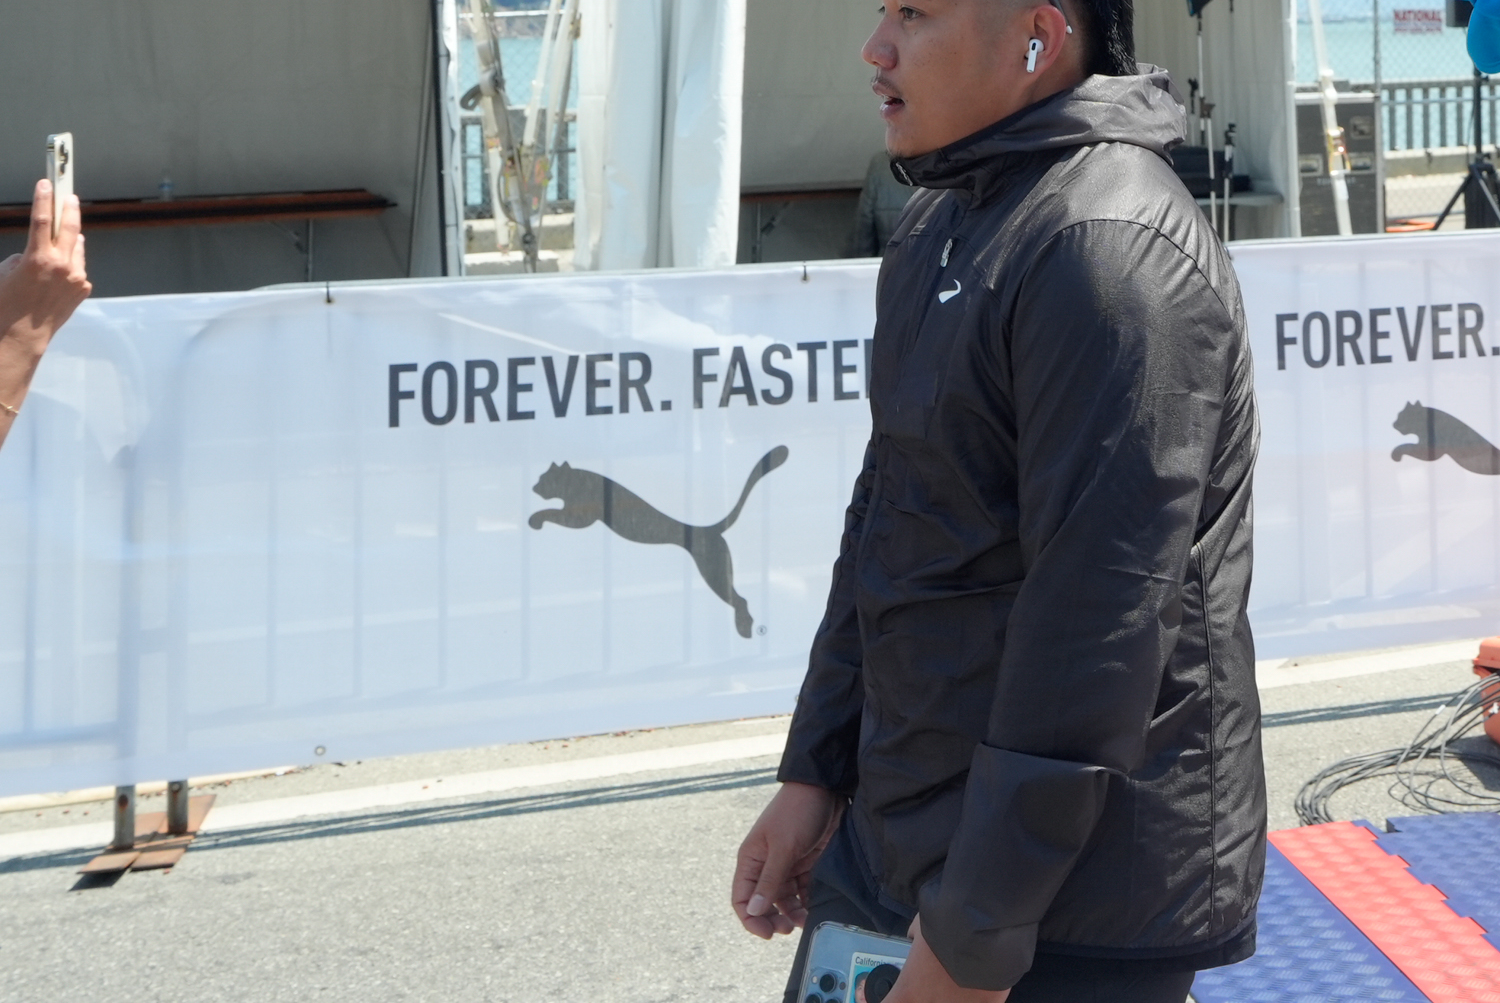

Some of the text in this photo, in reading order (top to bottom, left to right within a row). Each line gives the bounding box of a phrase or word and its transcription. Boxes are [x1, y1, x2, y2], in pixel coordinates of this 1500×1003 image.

[1393, 9, 1442, 22] NATIONAL
[1275, 302, 1500, 371] FOREVER.
[388, 338, 873, 428] FOREVER. FASTE
